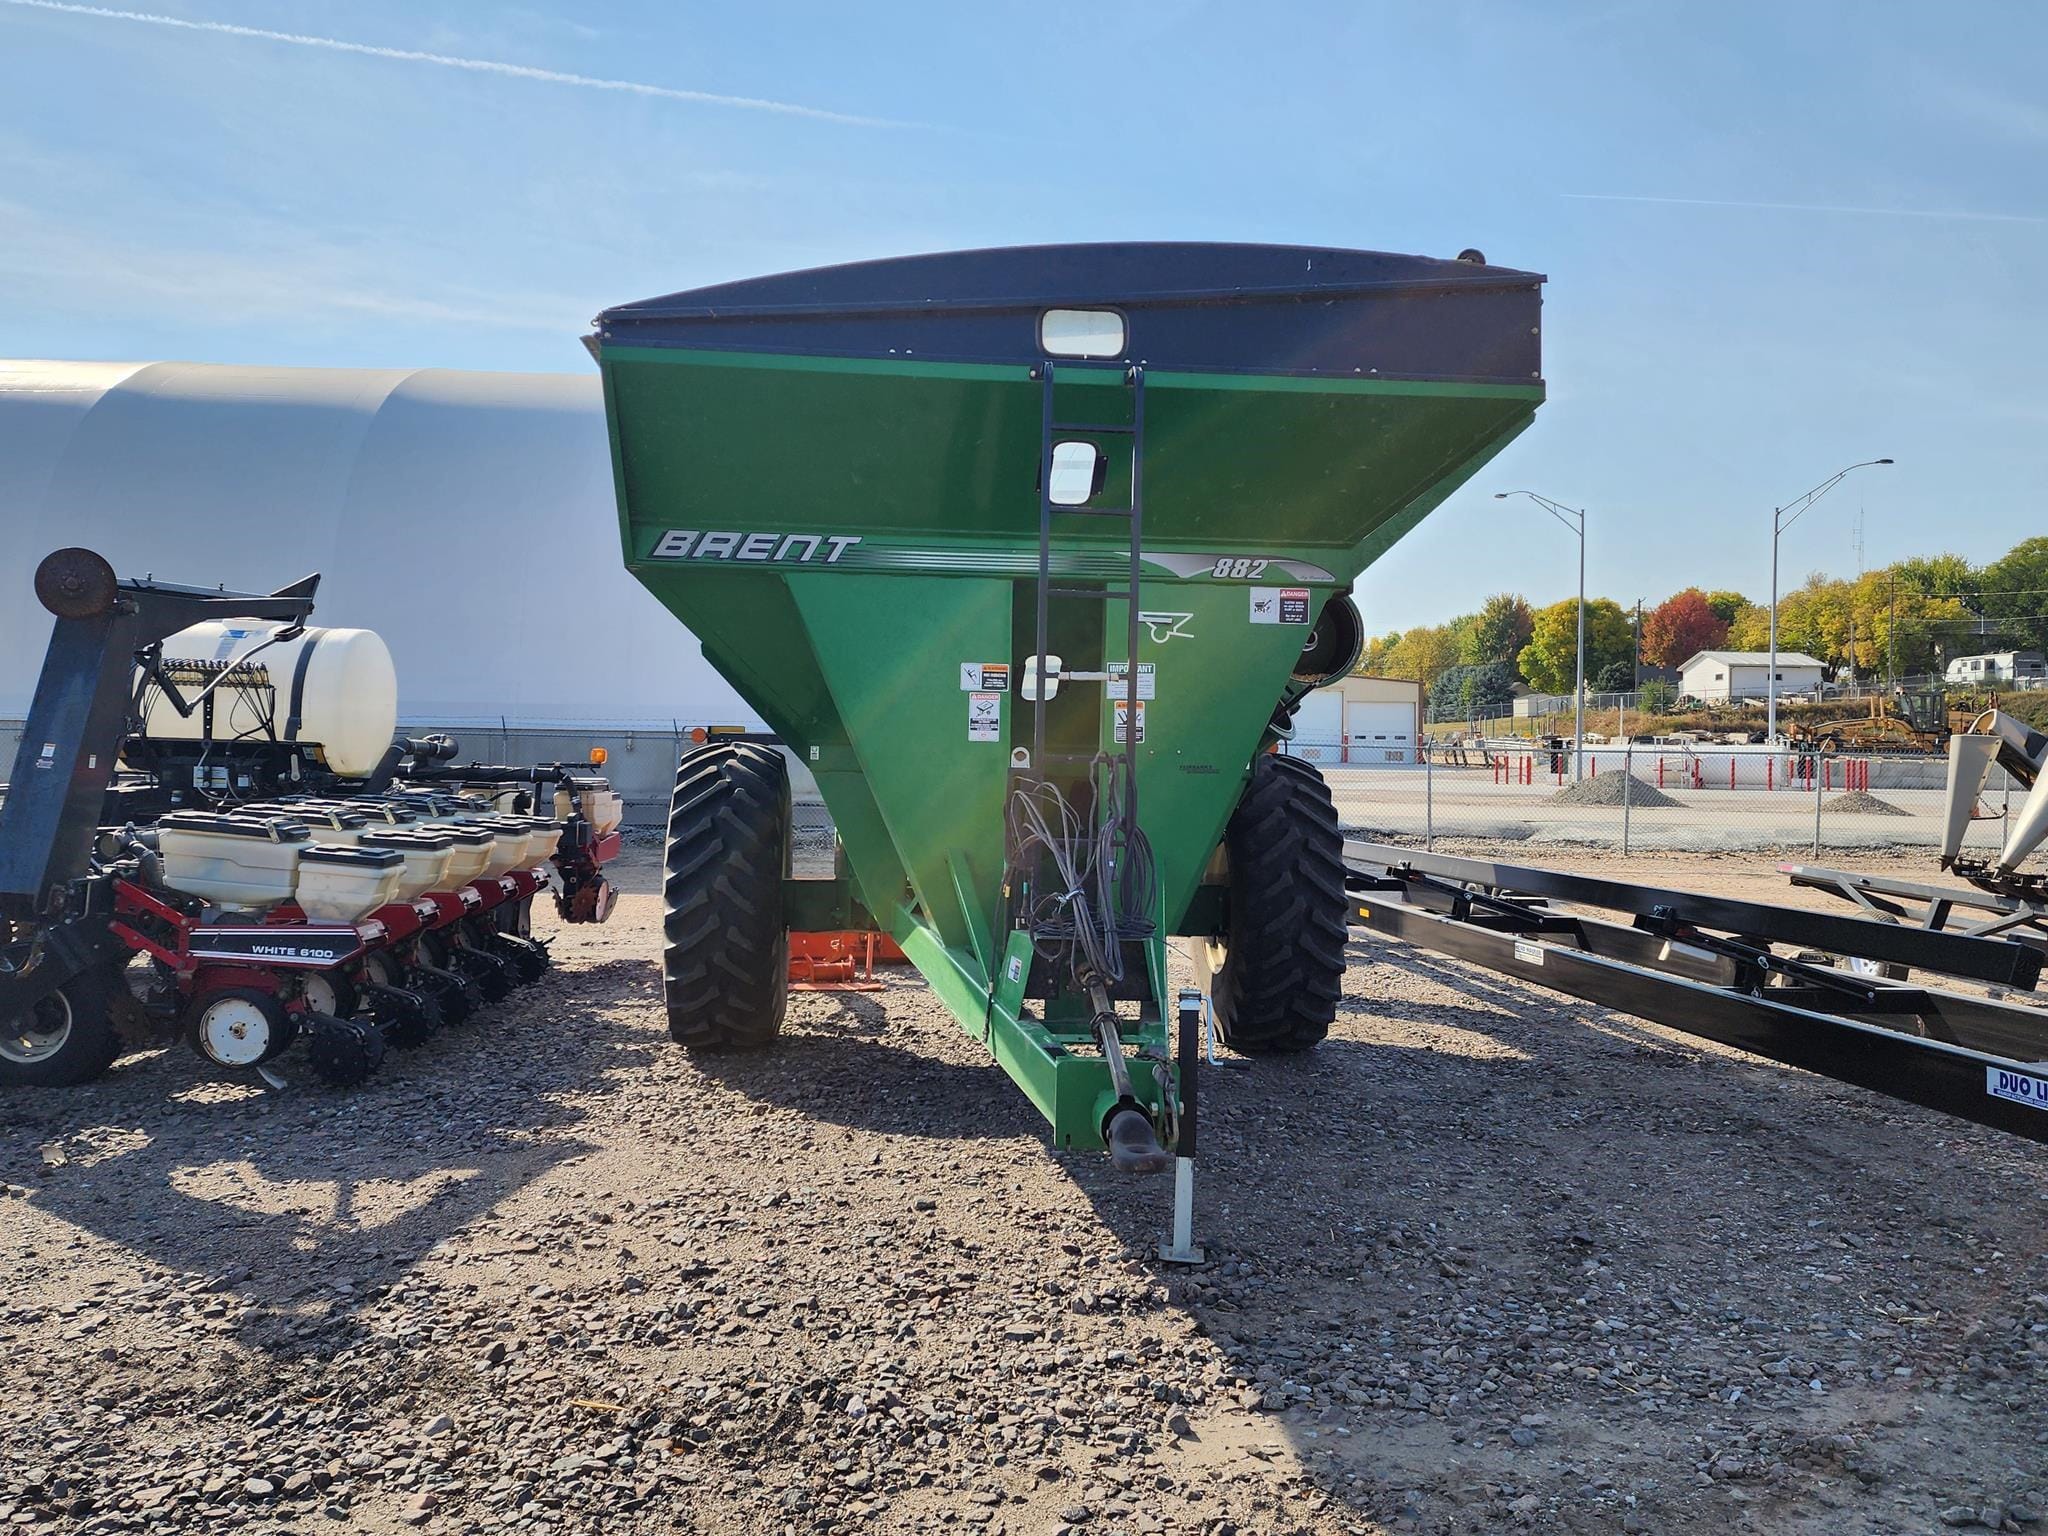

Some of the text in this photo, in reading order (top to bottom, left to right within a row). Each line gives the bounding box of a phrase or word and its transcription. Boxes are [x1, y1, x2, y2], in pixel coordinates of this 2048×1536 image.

[650, 529, 863, 563] BRENT
[1212, 558, 1269, 579] 882
[1109, 664, 1153, 673] IMPOANT
[252, 945, 333, 958] WHITE 6100
[2000, 1071, 2031, 1096] DUO
